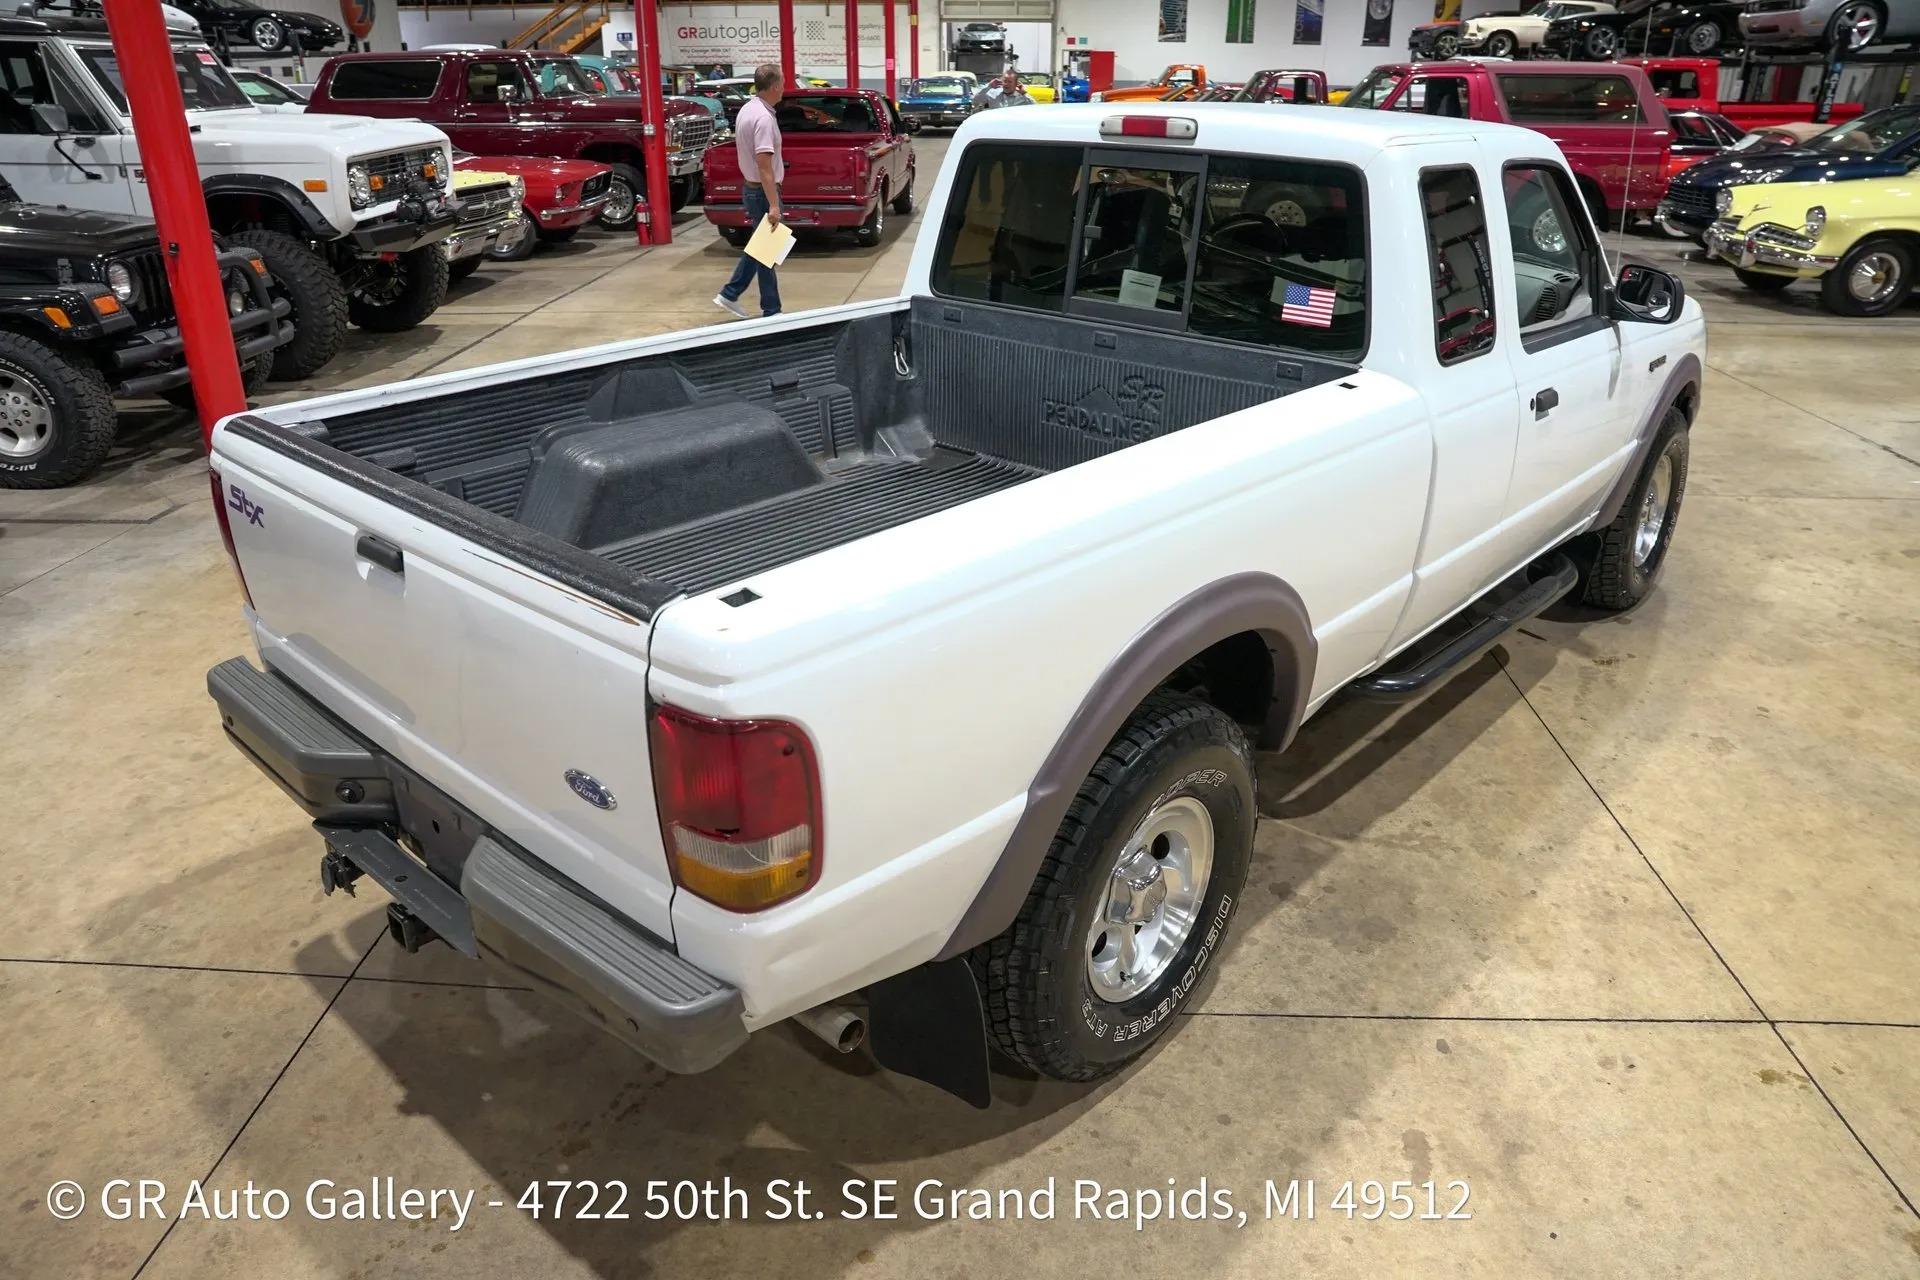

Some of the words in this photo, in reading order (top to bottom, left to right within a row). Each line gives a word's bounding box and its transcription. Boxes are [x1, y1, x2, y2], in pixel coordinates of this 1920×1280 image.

[677, 20, 797, 43] GRautogalle
[575, 779, 601, 804] Ford
[1113, 894, 1233, 1042] DISCOVERER
